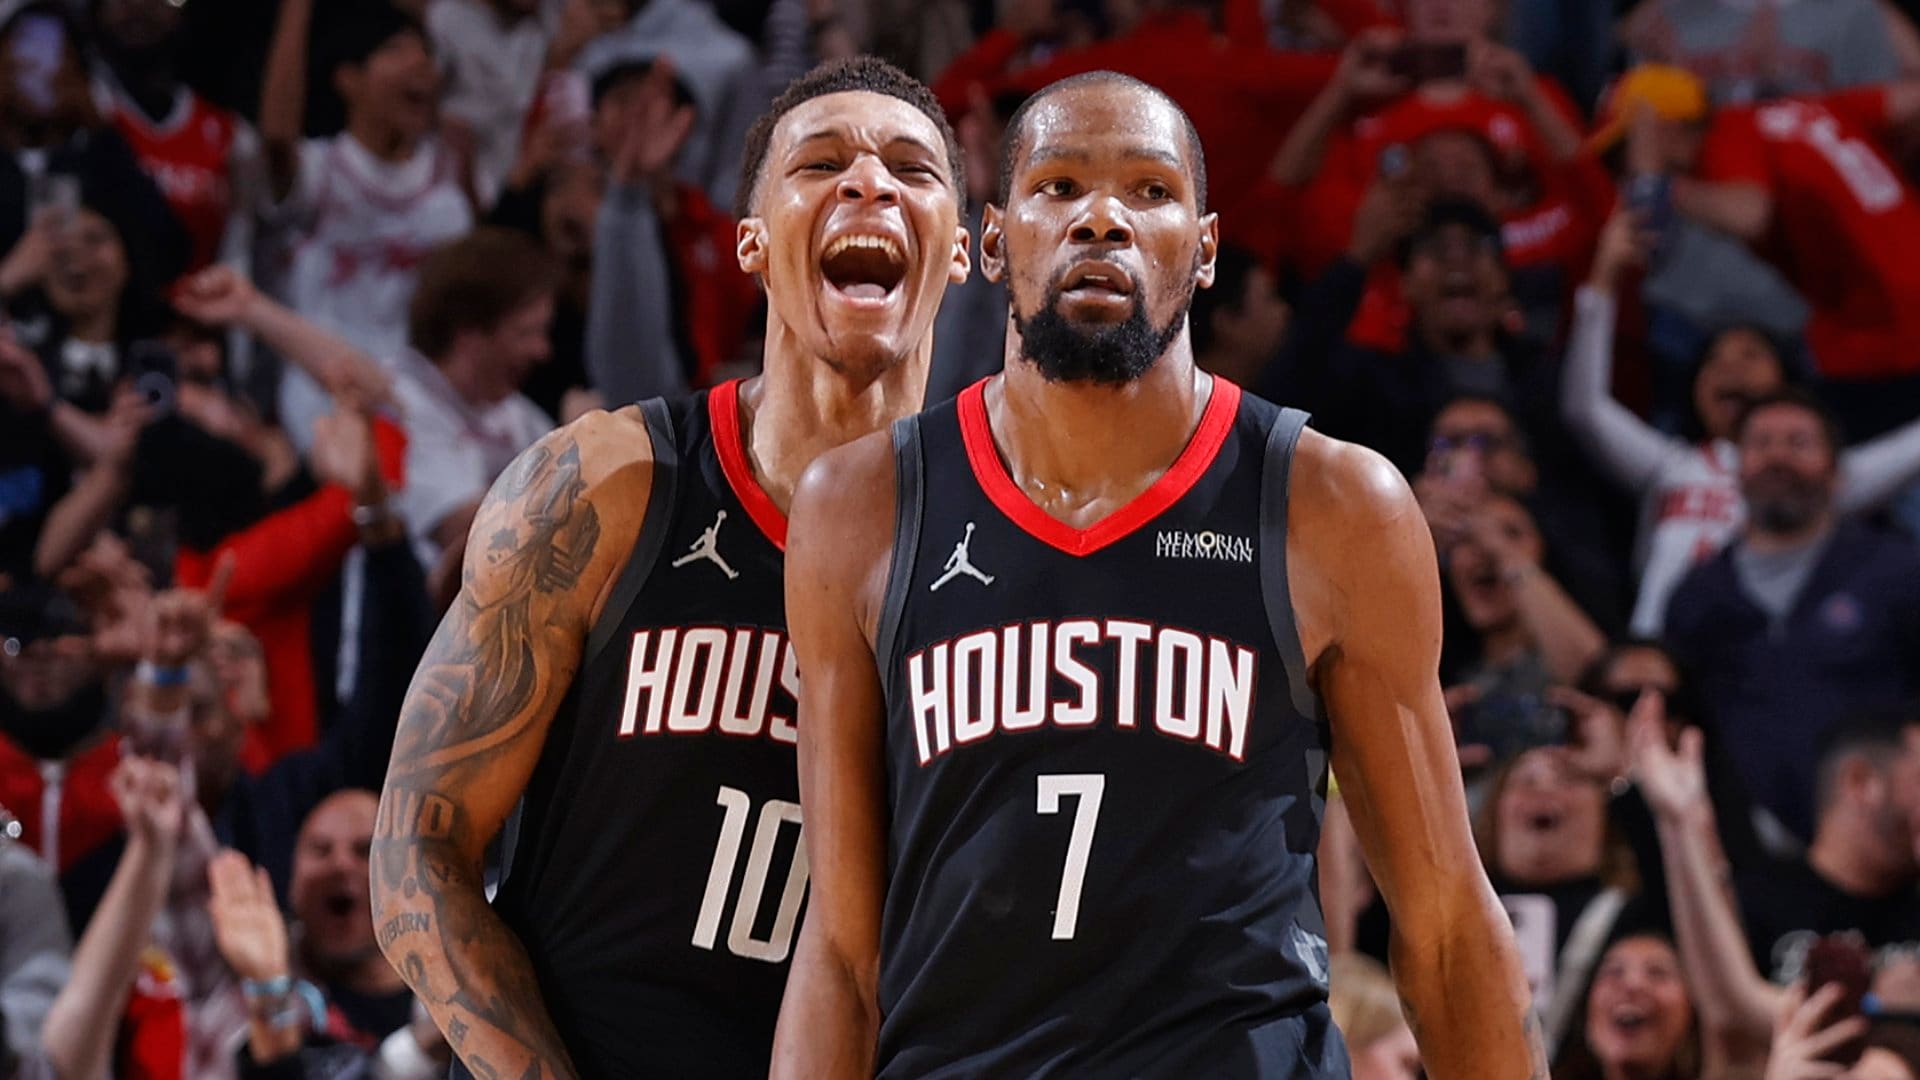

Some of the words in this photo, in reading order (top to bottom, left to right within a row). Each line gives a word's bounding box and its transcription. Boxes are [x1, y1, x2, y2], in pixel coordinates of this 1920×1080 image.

[1156, 530, 1252, 551] MEMORIAL
[1156, 543, 1253, 562] HERMANN
[908, 620, 1255, 766] HOUSTON
[691, 785, 811, 963] 10
[1037, 773, 1105, 940] 7
